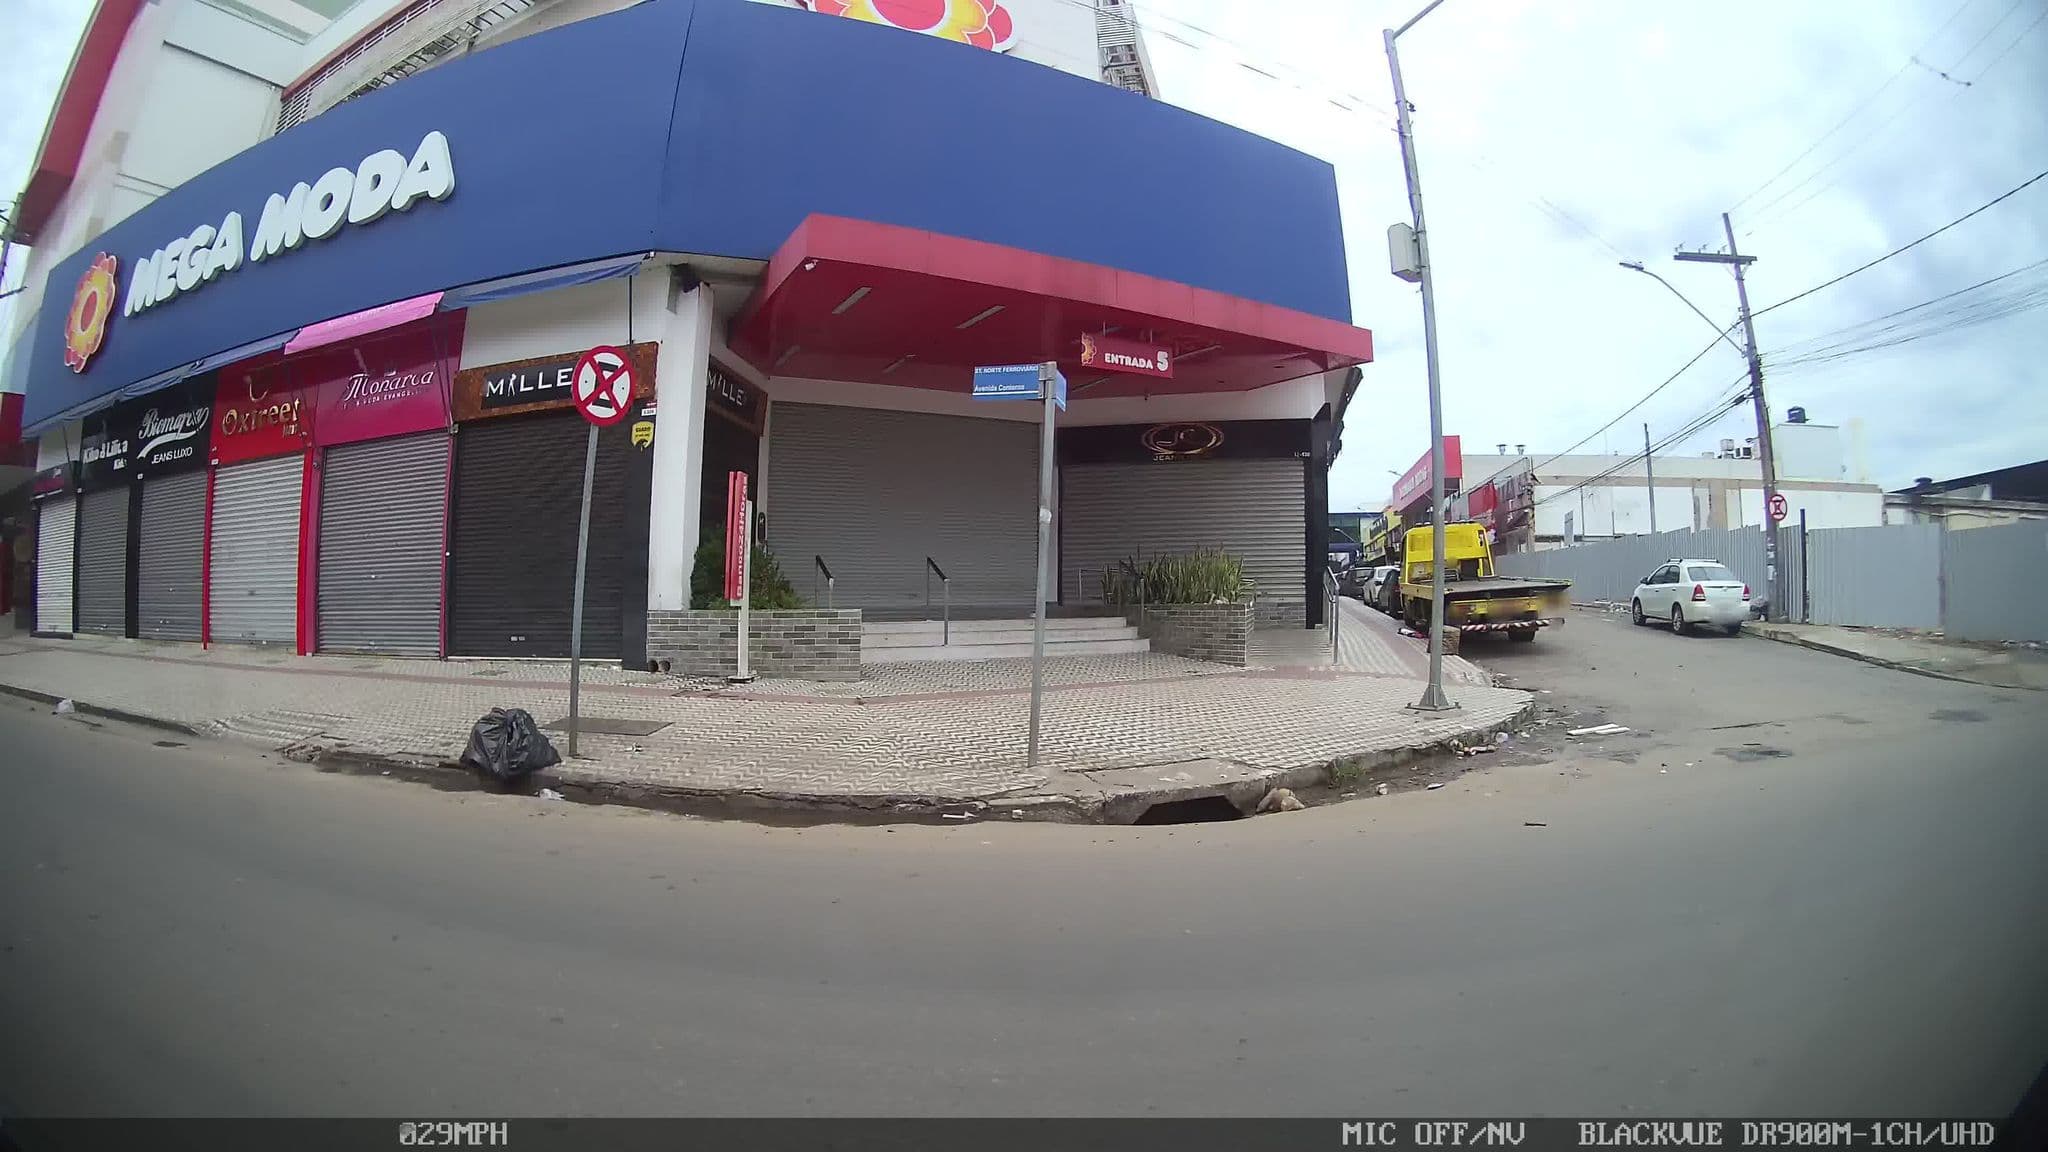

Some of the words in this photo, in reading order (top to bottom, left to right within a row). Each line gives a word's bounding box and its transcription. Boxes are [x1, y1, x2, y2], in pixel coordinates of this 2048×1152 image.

[125, 211, 244, 317] MEGA
[250, 130, 455, 262] MODA
[1104, 353, 1153, 369] ENTRADA
[1157, 351, 1168, 371] 5
[486, 367, 573, 397] MILLE
[151, 451, 173, 464] JEANS
[174, 447, 193, 460] LUXO
